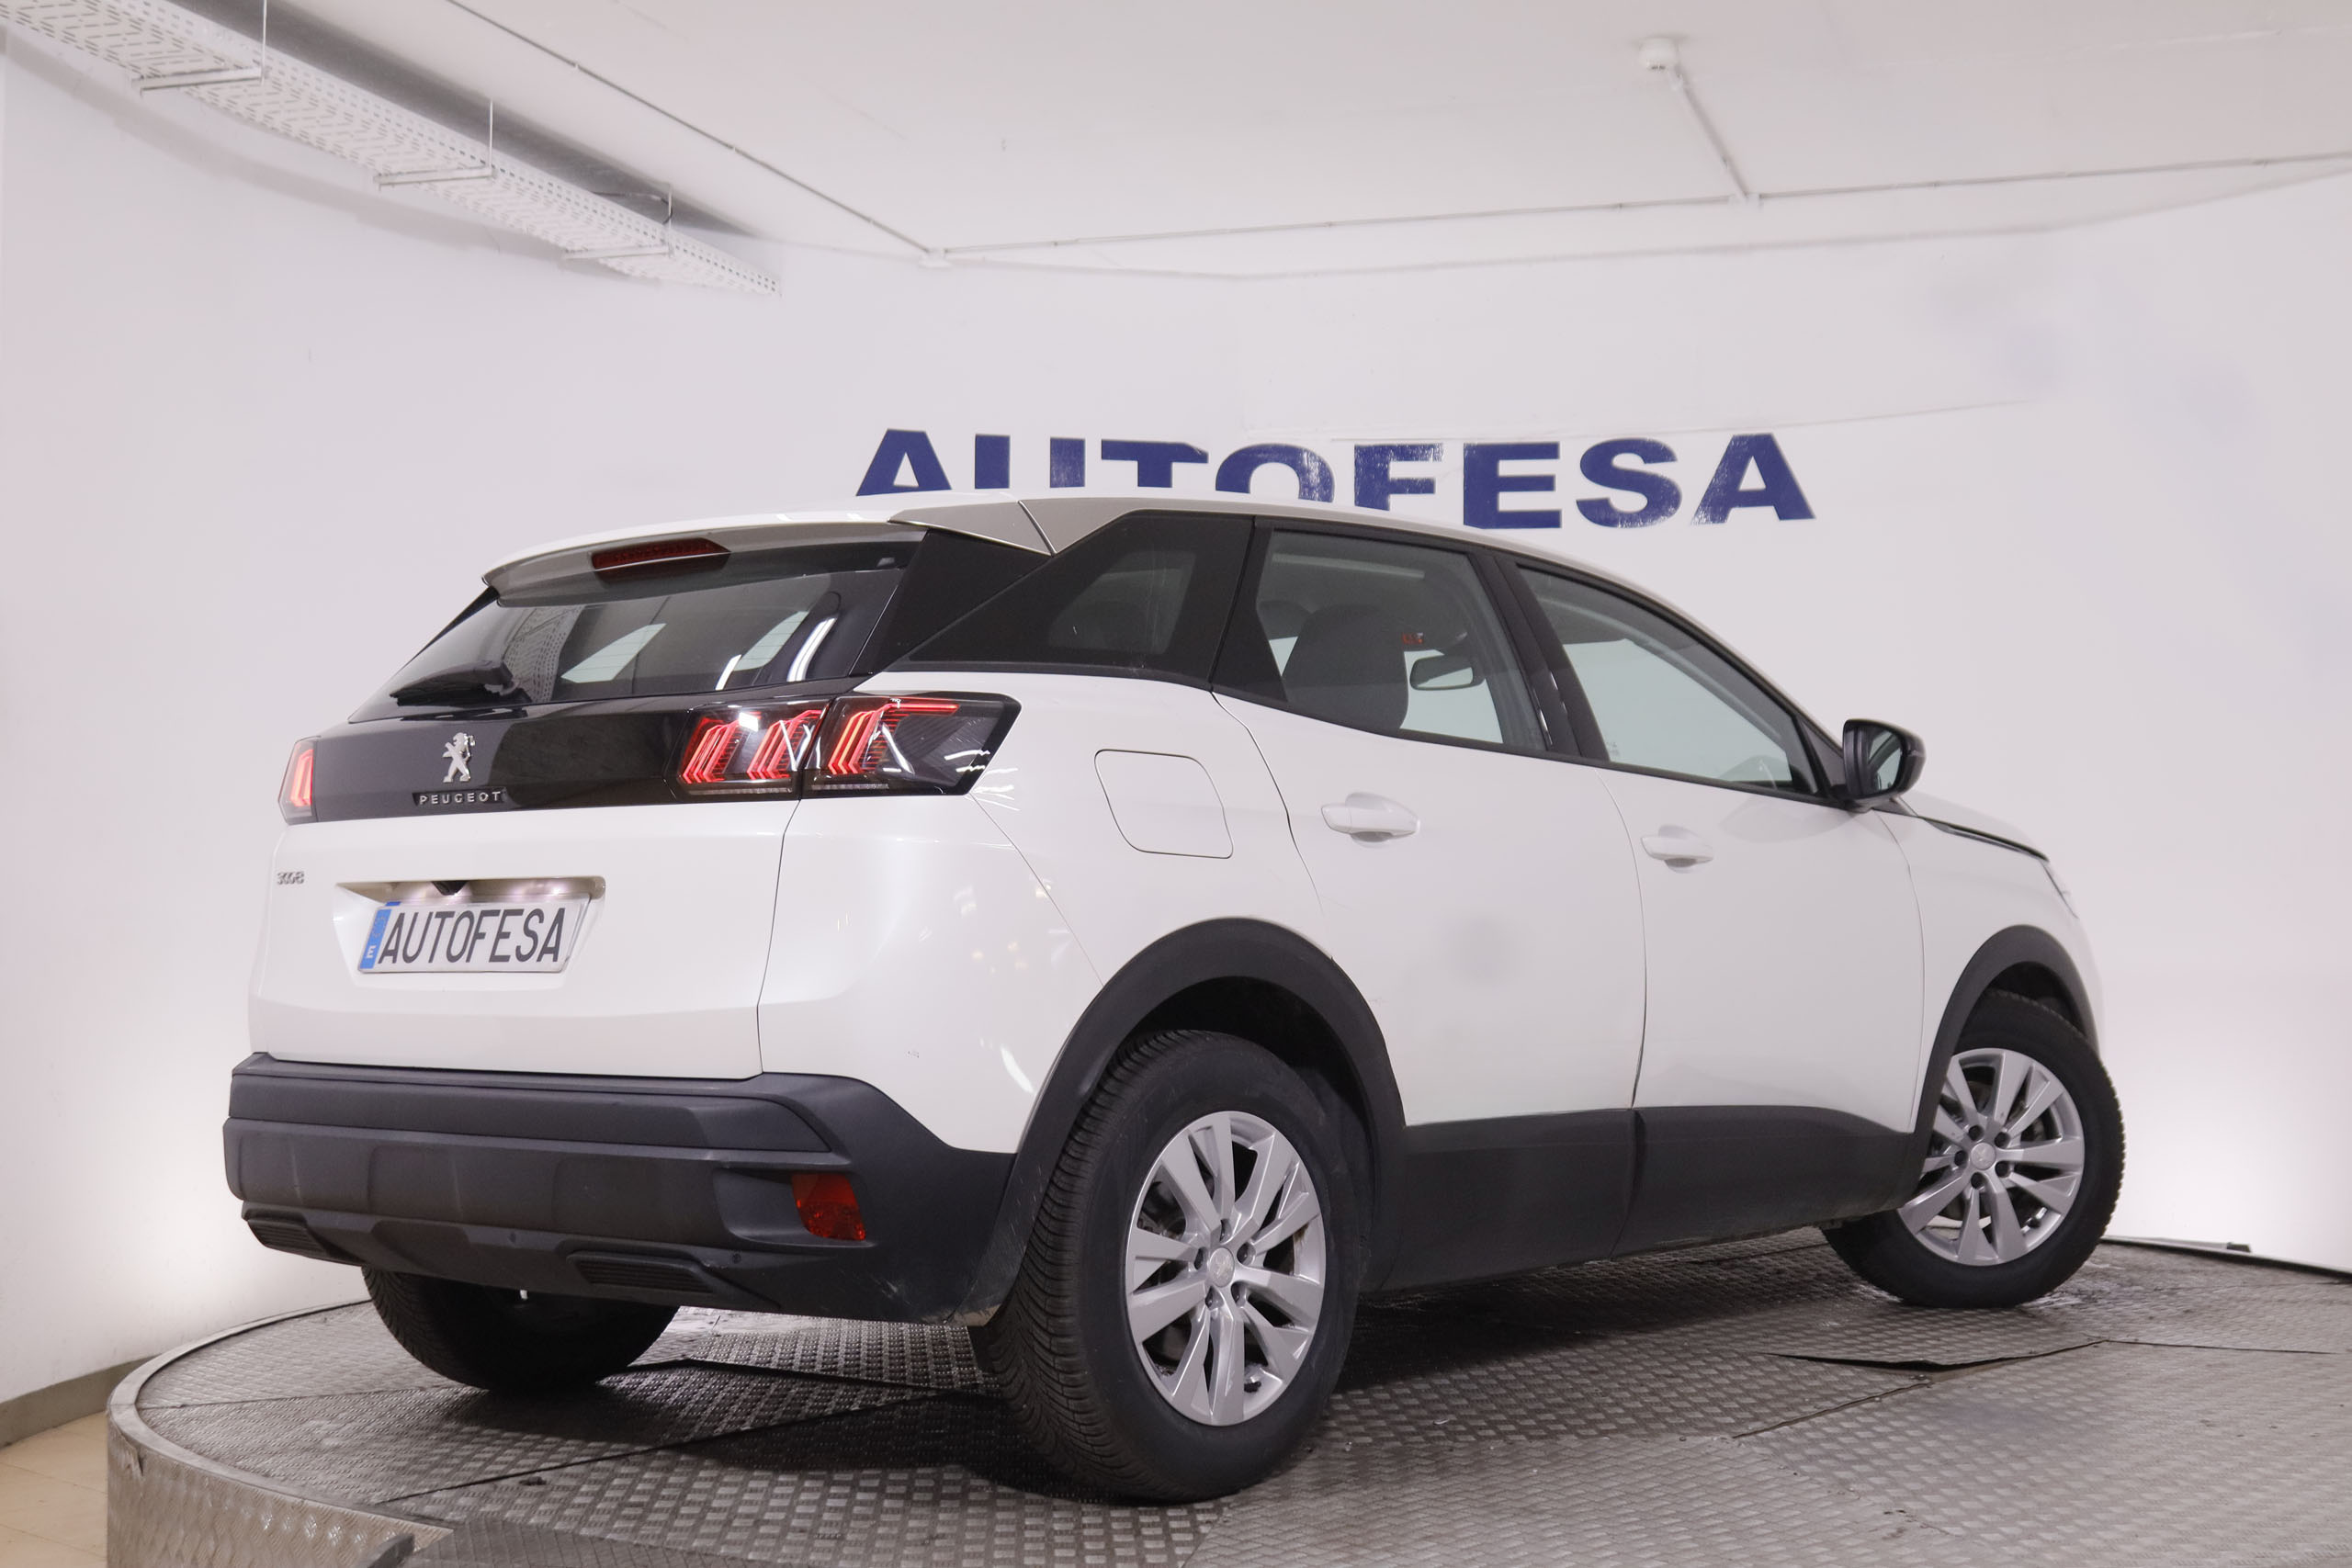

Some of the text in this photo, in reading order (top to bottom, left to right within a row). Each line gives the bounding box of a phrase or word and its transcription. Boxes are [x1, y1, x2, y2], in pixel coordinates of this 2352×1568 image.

[419, 791, 501, 805] PEUGEOT
[366, 908, 566, 964] E AUTOFESA
